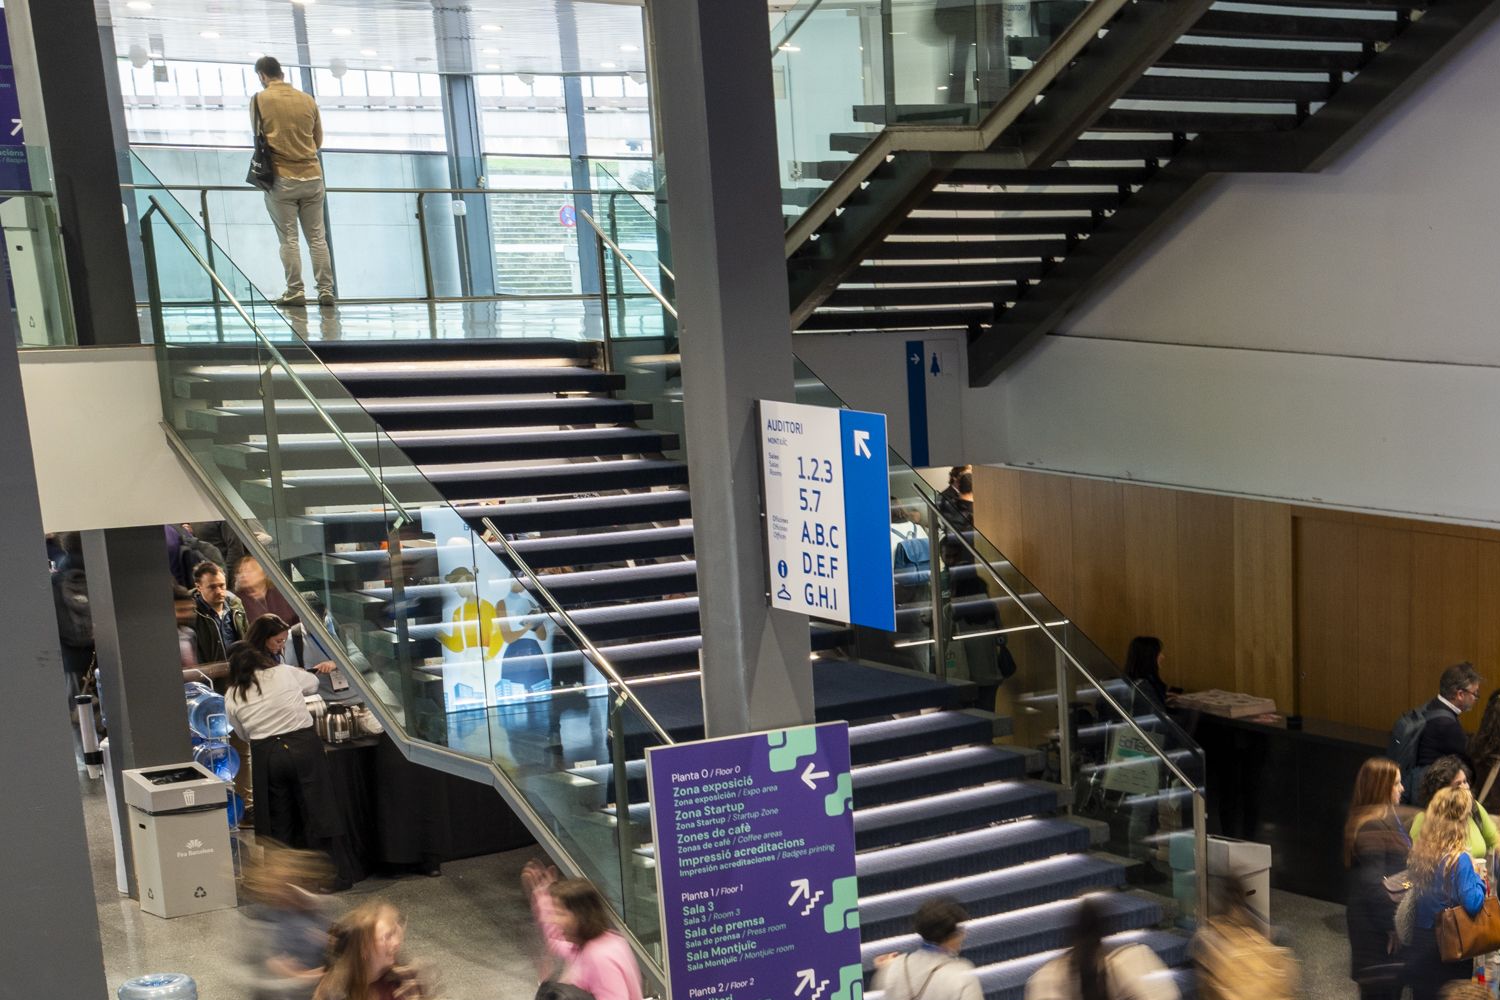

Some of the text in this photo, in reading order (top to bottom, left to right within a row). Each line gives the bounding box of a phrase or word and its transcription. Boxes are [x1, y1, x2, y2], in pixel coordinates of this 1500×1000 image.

[767, 419, 803, 435] AUDITORI
[798, 456, 833, 483] 1.2.3
[799, 488, 821, 512] 5.7
[802, 521, 839, 549] A.B.C
[803, 551, 838, 579] D.E.F
[805, 583, 838, 610] G.H.I
[671, 772, 700, 783] Planta
[701, 770, 709, 779] 0
[714, 768, 734, 777] Floor
[735, 766, 741, 774] 0
[672, 775, 753, 797] Zona exposició
[673, 799, 693, 807] Zona
[694, 791, 736, 804] exposición
[743, 788, 761, 796] Expo
[762, 785, 778, 793] area
[674, 802, 745, 821] Zona Startup
[675, 822, 695, 831] Zona
[696, 817, 726, 827] Startup
[732, 811, 760, 821] Startup
[760, 808, 779, 817] Zone
[676, 822, 751, 844] Zones de cafè
[677, 845, 701, 854] Zonas
[702, 842, 713, 850] de
[737, 834, 762, 844] Coffee
[763, 831, 783, 839] areas
[678, 839, 805, 868] Impressió acreditacions
[679, 864, 719, 877] Impresión
[719, 855, 775, 870] acreditaciones
[782, 849, 807, 859] Badges
[808, 844, 836, 856] printing
[681, 890, 709, 903] Planta
[711, 889, 715, 897] 1
[720, 886, 739, 895] Floor
[682, 901, 715, 916] Sala 3
[683, 917, 700, 926] Sala
[701, 915, 706, 923] 3
[713, 911, 734, 920] Room
[735, 908, 741, 916] 3
[684, 917, 765, 939] Sala de premsa
[685, 940, 702, 949] Sala
[714, 933, 741, 945] prensa
[746, 928, 766, 937] Press
[767, 924, 787, 932] room
[686, 941, 757, 962] Sala Montjuïc
[687, 963, 704, 972] Sala
[776, 945, 795, 953] room
[689, 986, 716, 999] Planta
[718, 984, 725, 992] 2
[730, 981, 749, 990] Floor
[749, 978, 755, 986] 2
